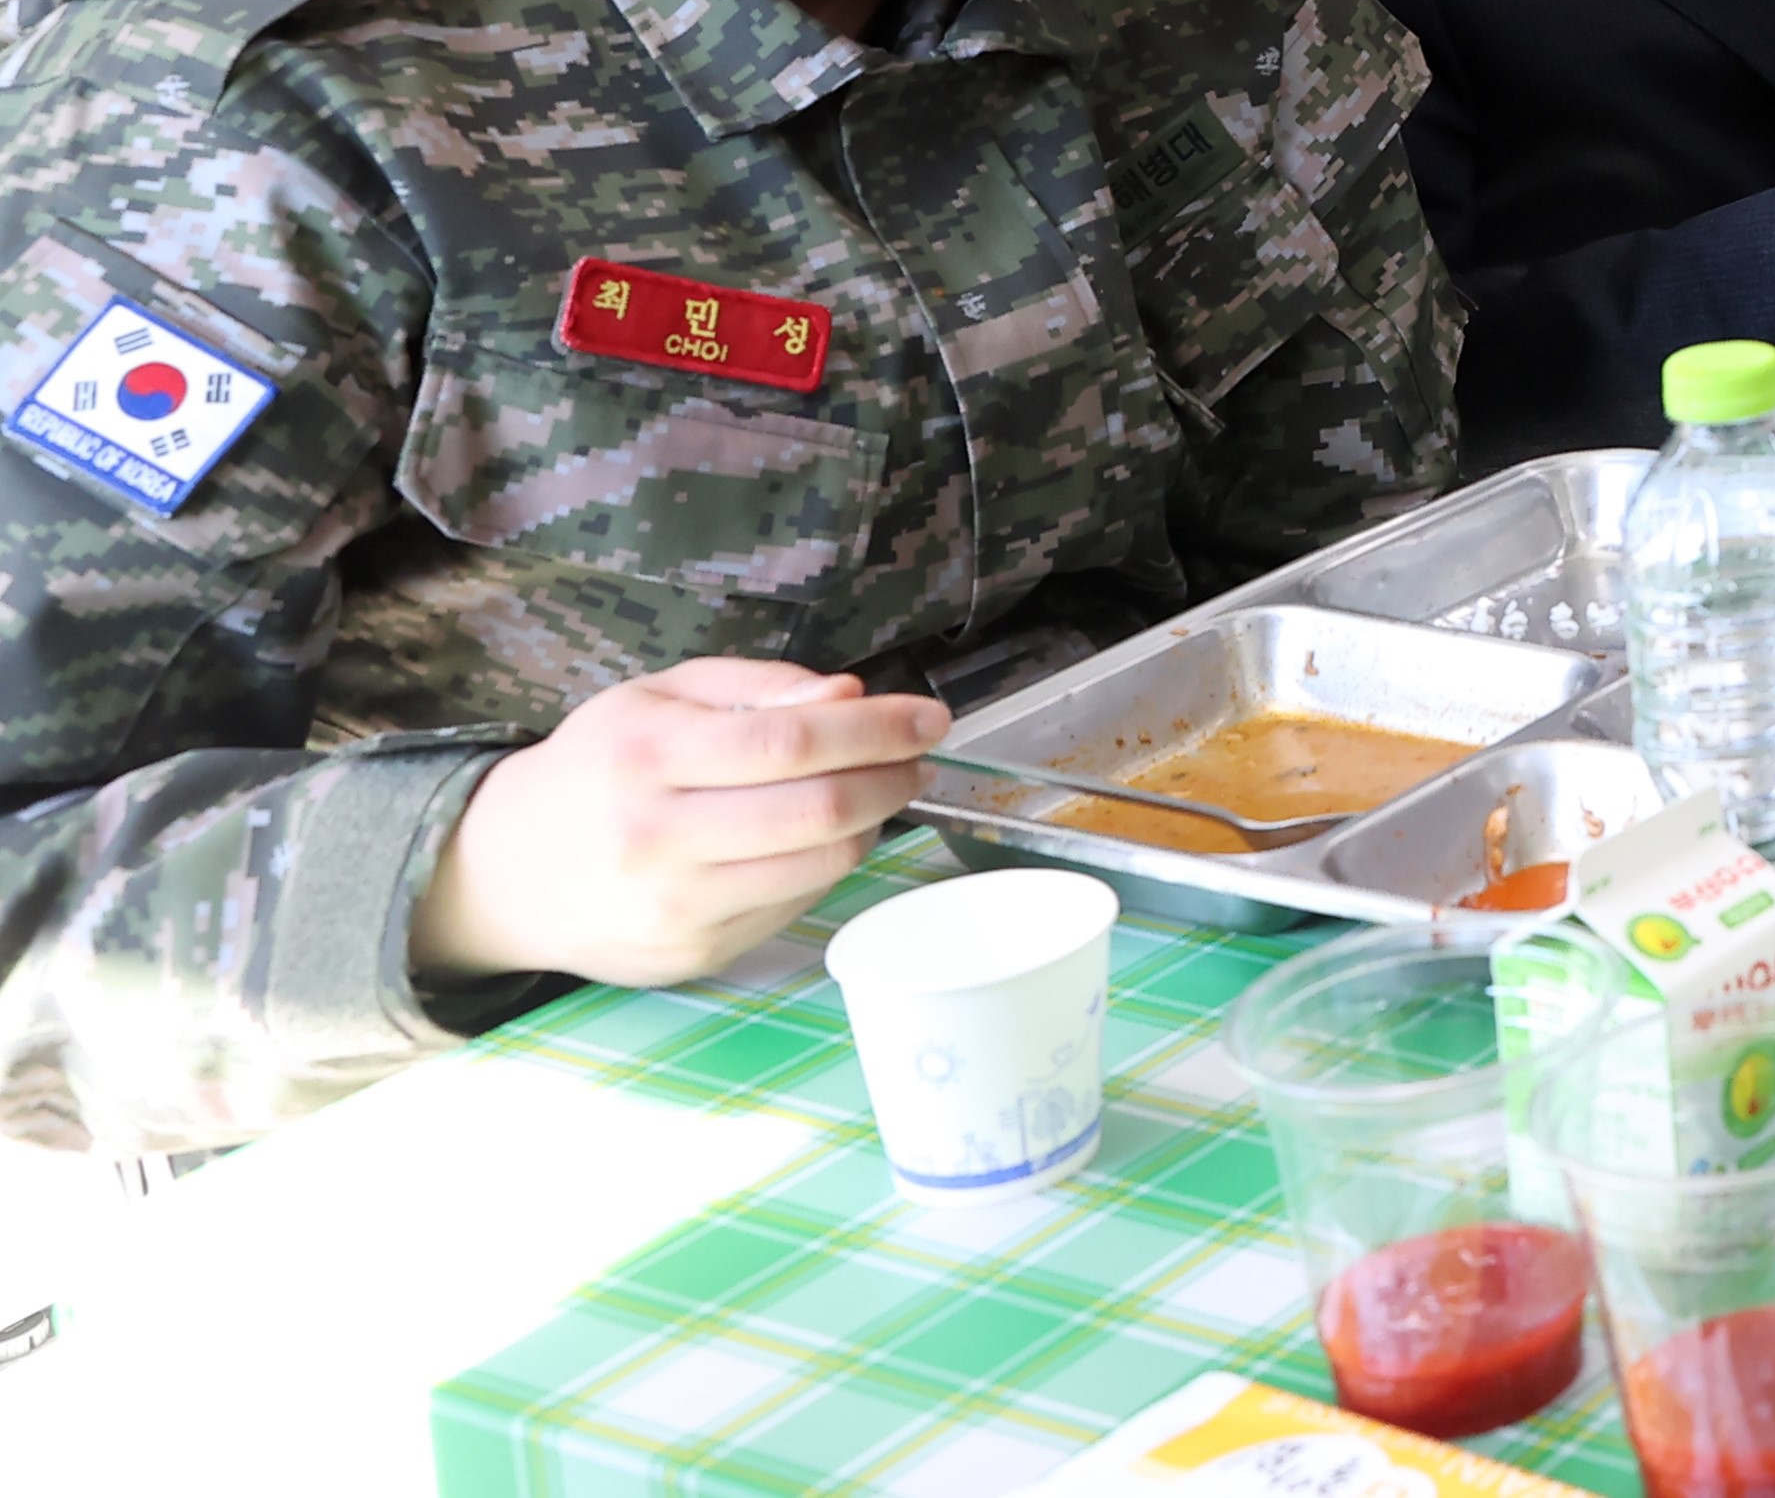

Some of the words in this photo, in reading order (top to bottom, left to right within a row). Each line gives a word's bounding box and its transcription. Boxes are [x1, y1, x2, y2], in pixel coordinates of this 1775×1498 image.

[685, 297, 720, 339] 민
[772, 316, 810, 356] 성
[664, 333, 729, 363] CHOI
[91, 442, 128, 473] OF
